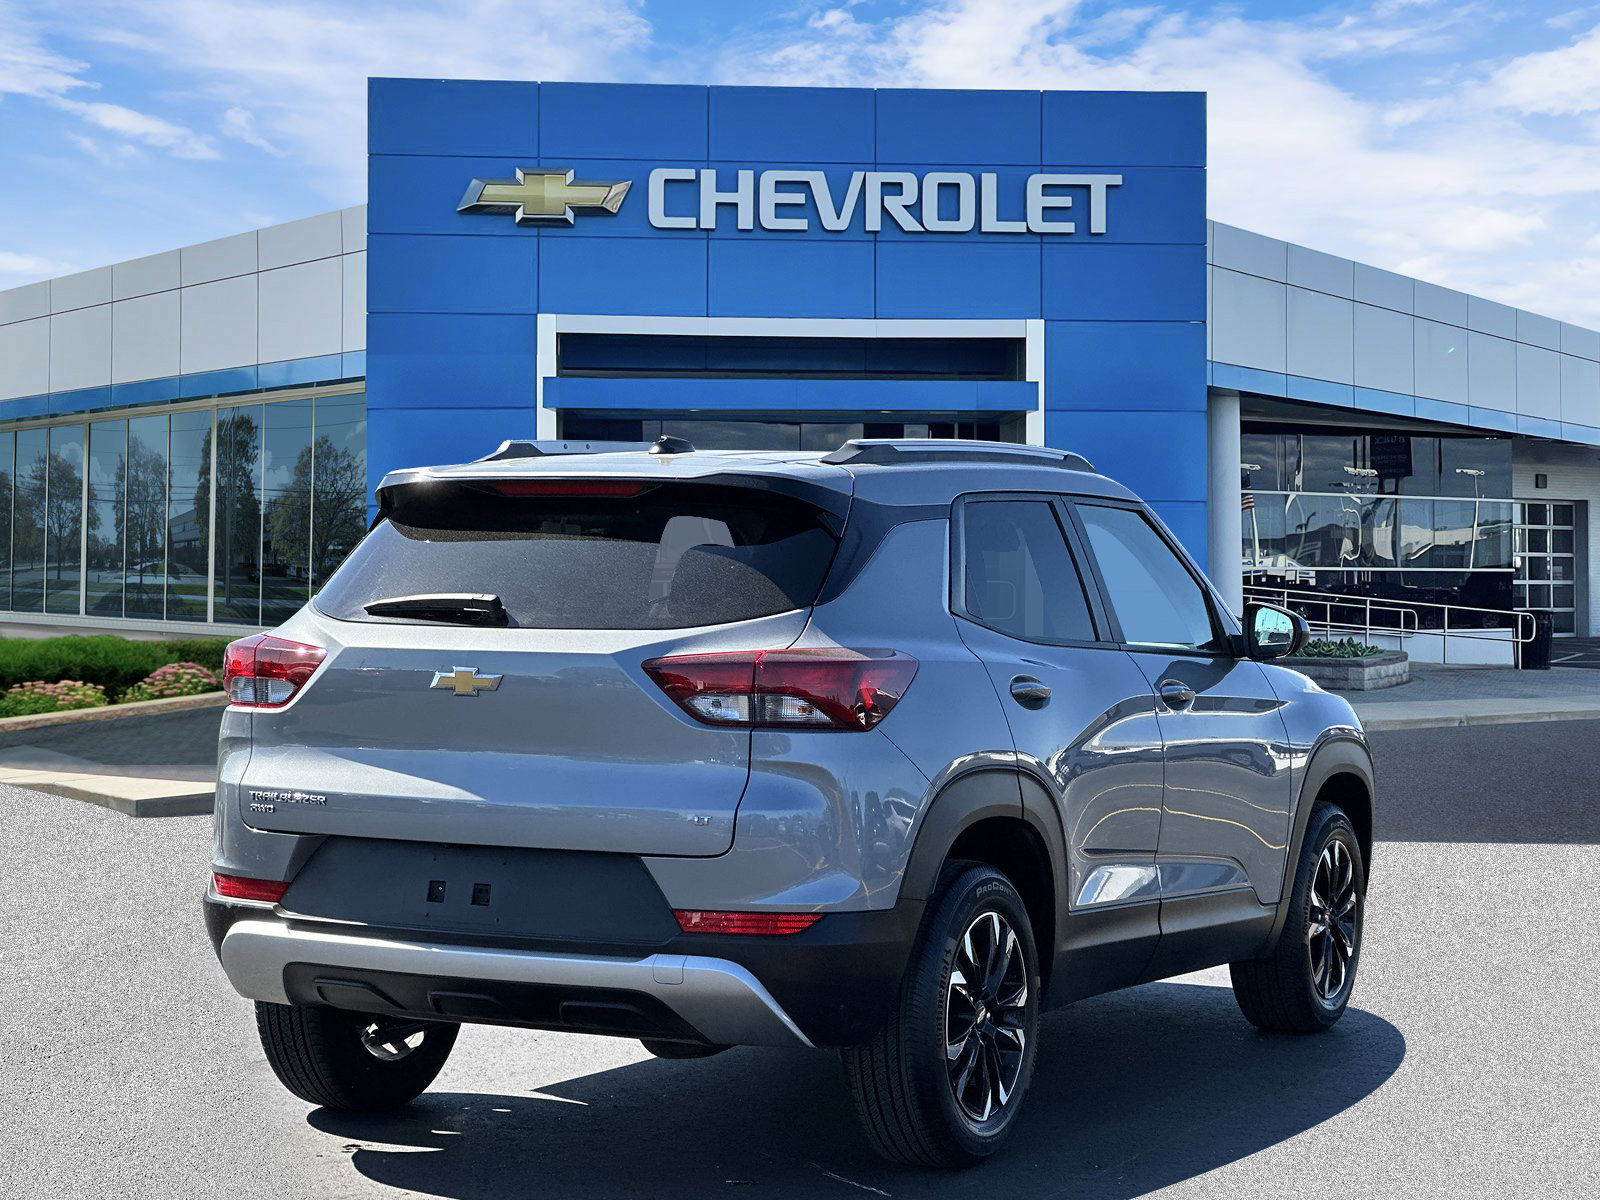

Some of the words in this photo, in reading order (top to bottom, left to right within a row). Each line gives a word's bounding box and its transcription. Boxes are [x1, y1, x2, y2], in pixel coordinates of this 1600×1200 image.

[648, 167, 1123, 234] CHEVROLET
[248, 788, 327, 805] TRAILBLAZER
[250, 803, 275, 813] AWD
[693, 815, 711, 826] LT
